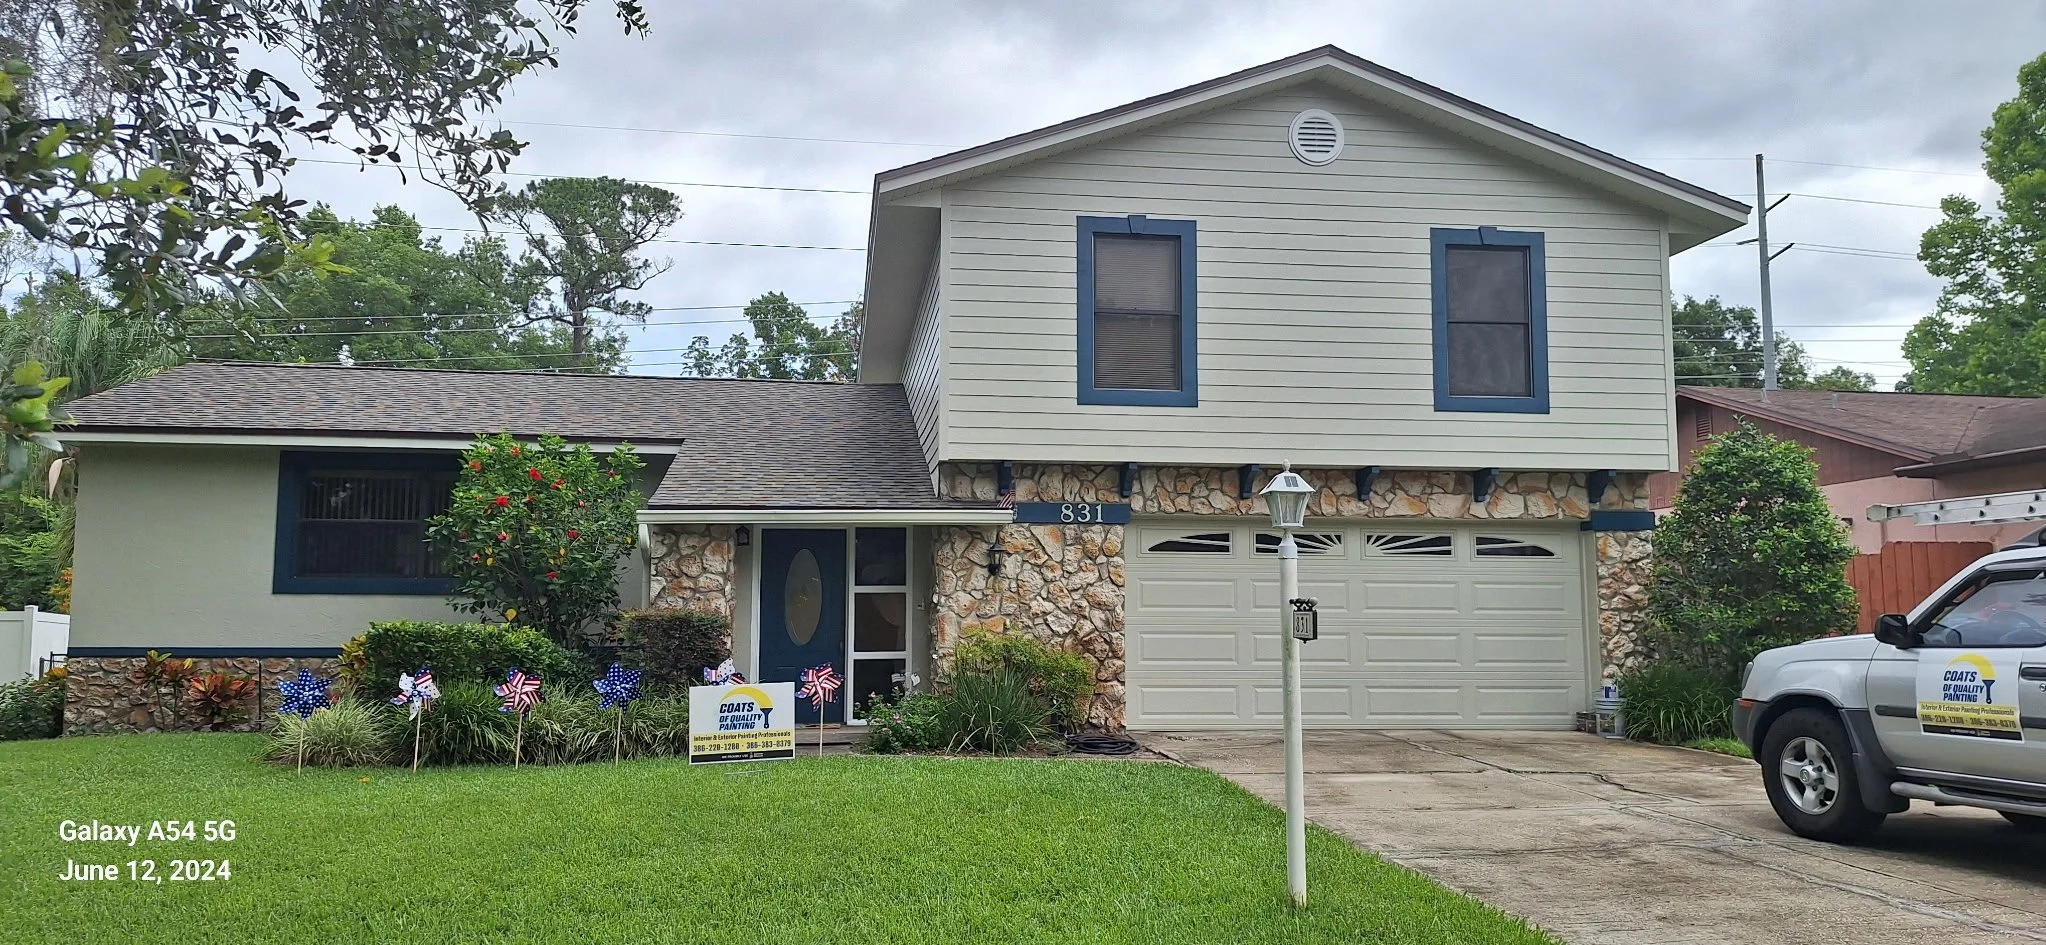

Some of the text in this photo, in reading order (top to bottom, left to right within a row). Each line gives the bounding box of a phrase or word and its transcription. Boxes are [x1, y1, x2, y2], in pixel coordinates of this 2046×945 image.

[1060, 503, 1103, 523] 831
[1295, 616, 1309, 634] 831
[1943, 670, 1977, 682] COATS
[1942, 683, 1984, 694] OF QUALITY
[1943, 692, 1978, 703] PAINTING
[719, 702, 755, 713] COATS
[719, 713, 763, 723] OF QUALITY
[718, 721, 756, 731] PAINTING
[693, 734, 713, 742] Interior
[737, 732, 758, 740] Painting
